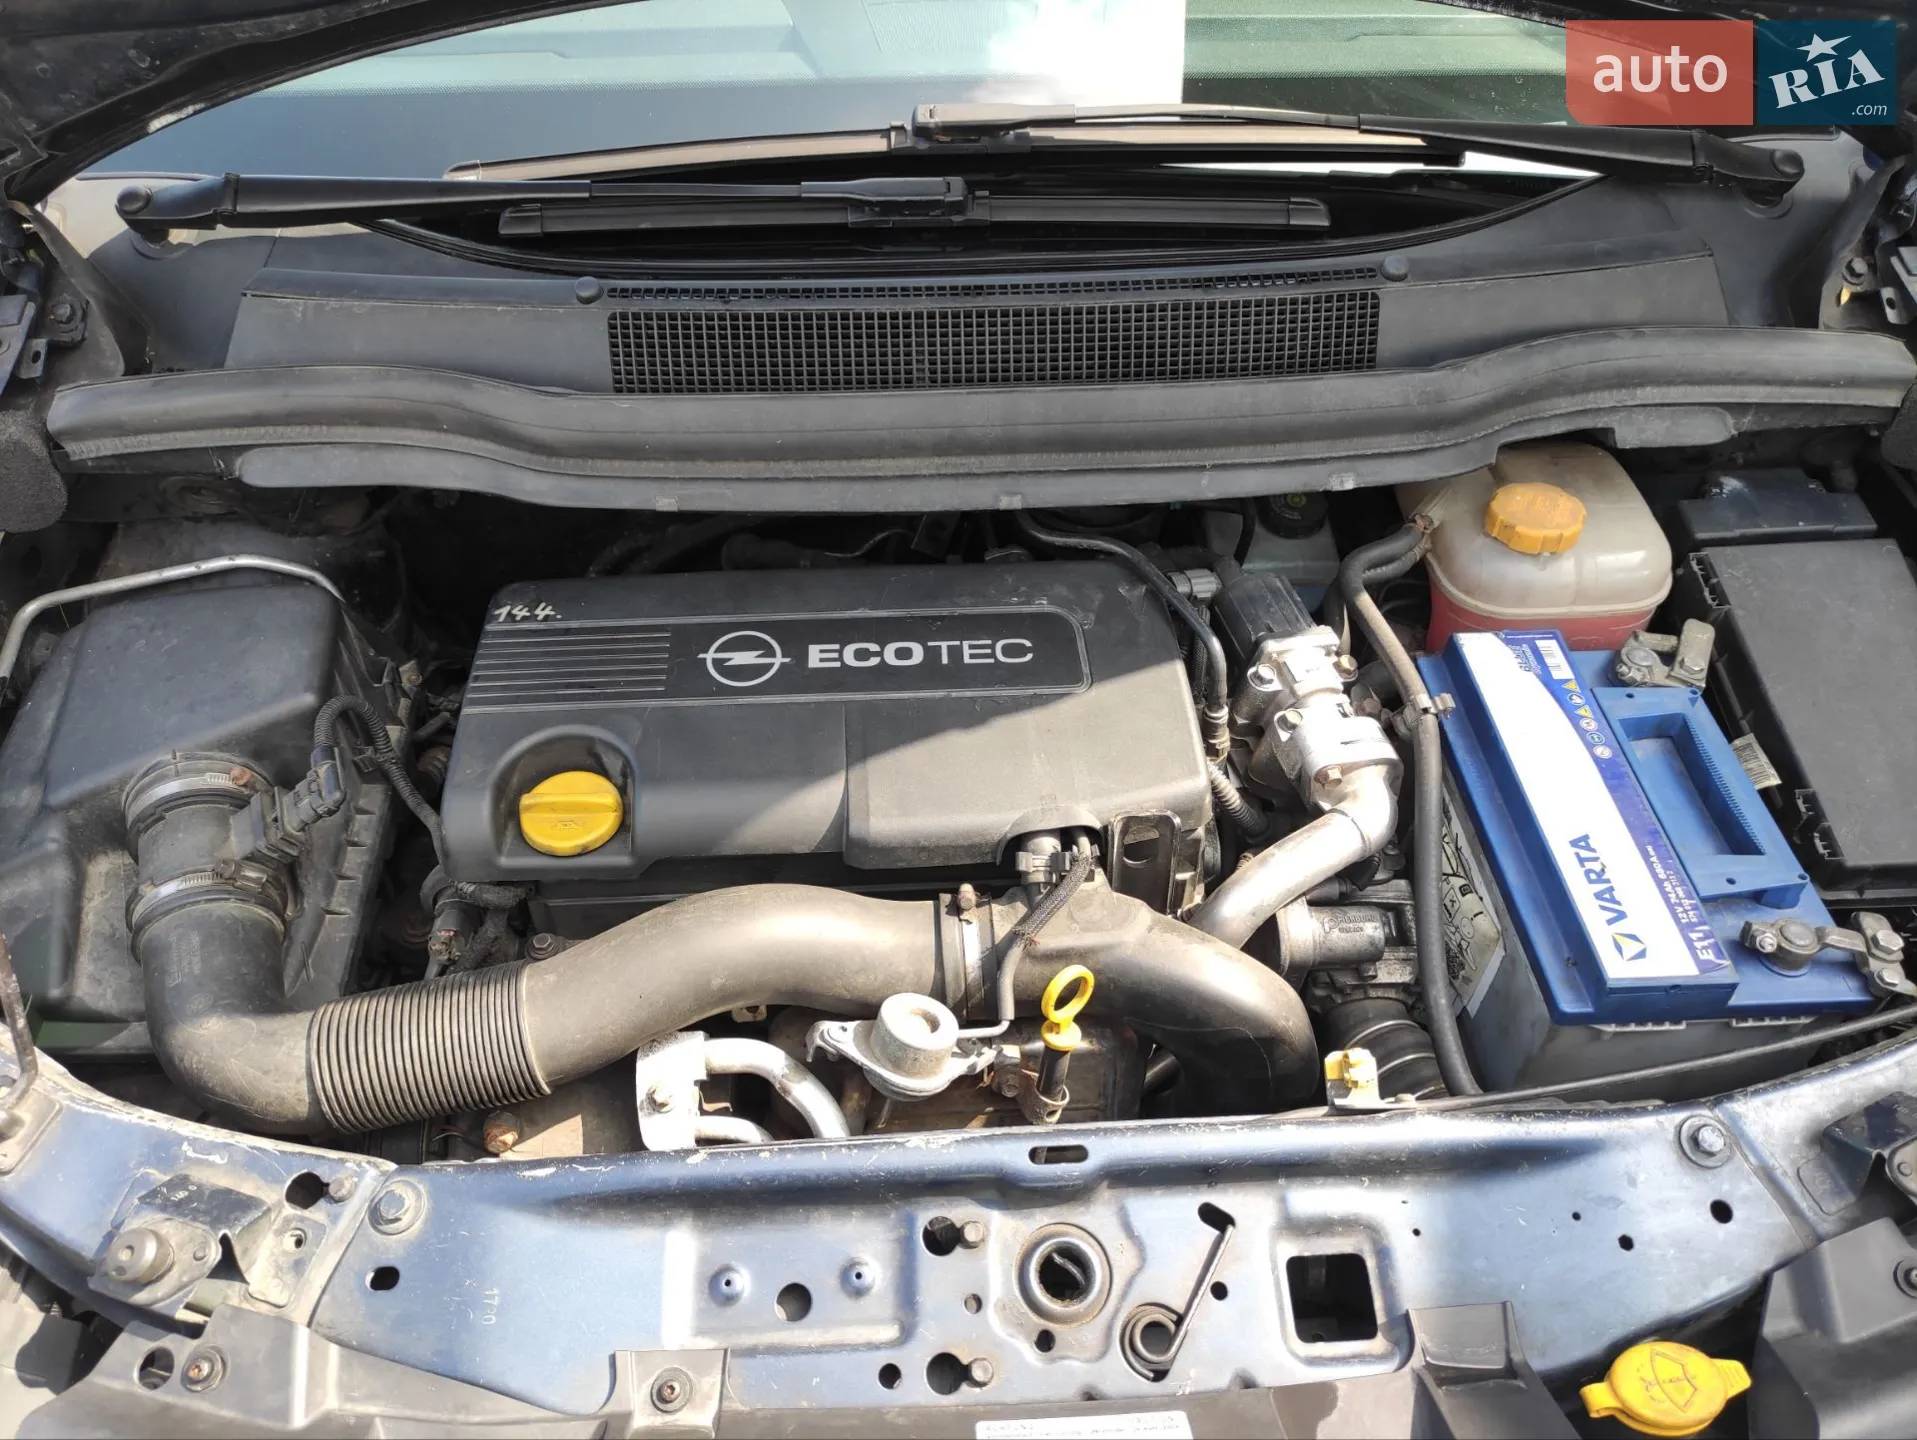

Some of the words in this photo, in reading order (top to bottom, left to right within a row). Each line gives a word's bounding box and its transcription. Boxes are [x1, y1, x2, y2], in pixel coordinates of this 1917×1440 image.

[808, 638, 1034, 668] ECOTEC
[1568, 833, 1628, 926] VARTA
[1688, 931, 1716, 962] E11
